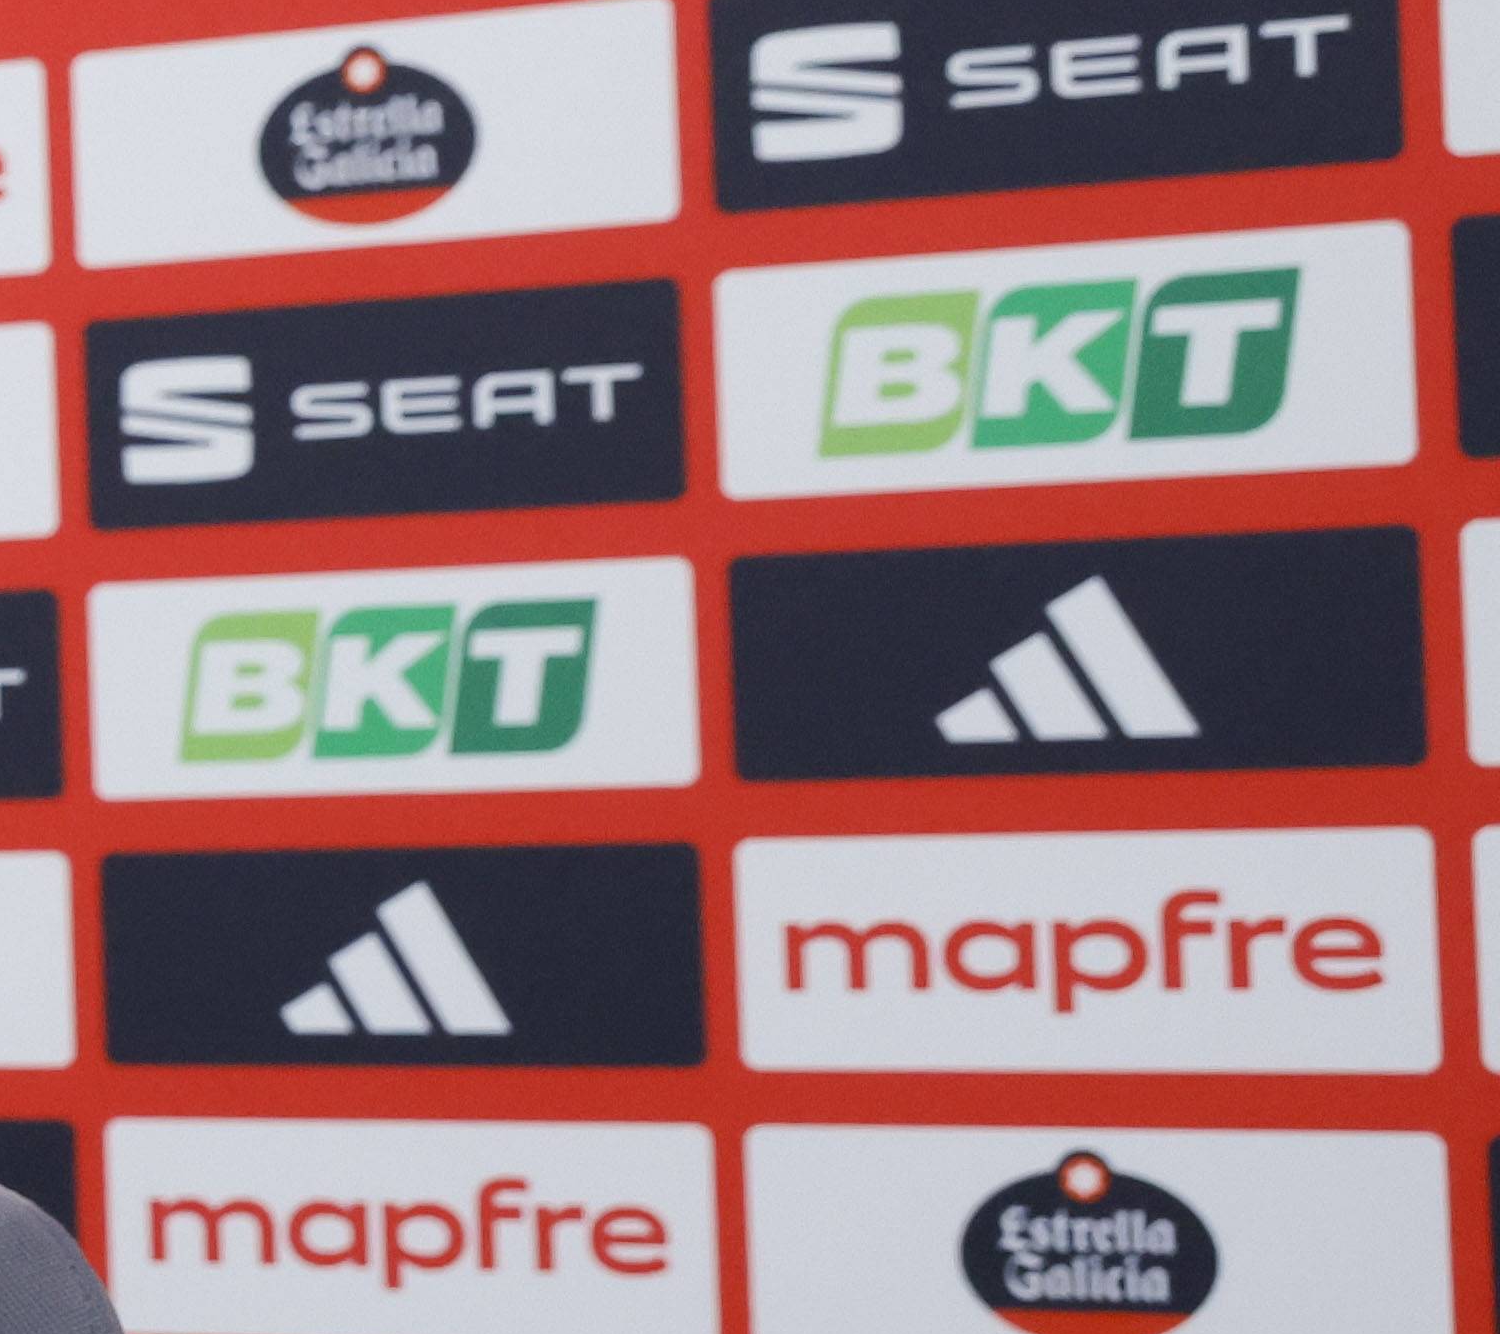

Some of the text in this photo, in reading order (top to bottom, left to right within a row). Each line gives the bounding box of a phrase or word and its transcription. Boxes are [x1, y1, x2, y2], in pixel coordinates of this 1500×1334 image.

[947, 15, 1350, 109] SEAT
[291, 363, 642, 439] SEAT
[823, 273, 1296, 450] BKT
[183, 603, 591, 755] BKT
[786, 891, 1382, 1012] mapfre
[151, 1179, 666, 1288] mapfre
[998, 1204, 1176, 1255] Estrella
[1005, 1249, 1172, 1302] Galicia
